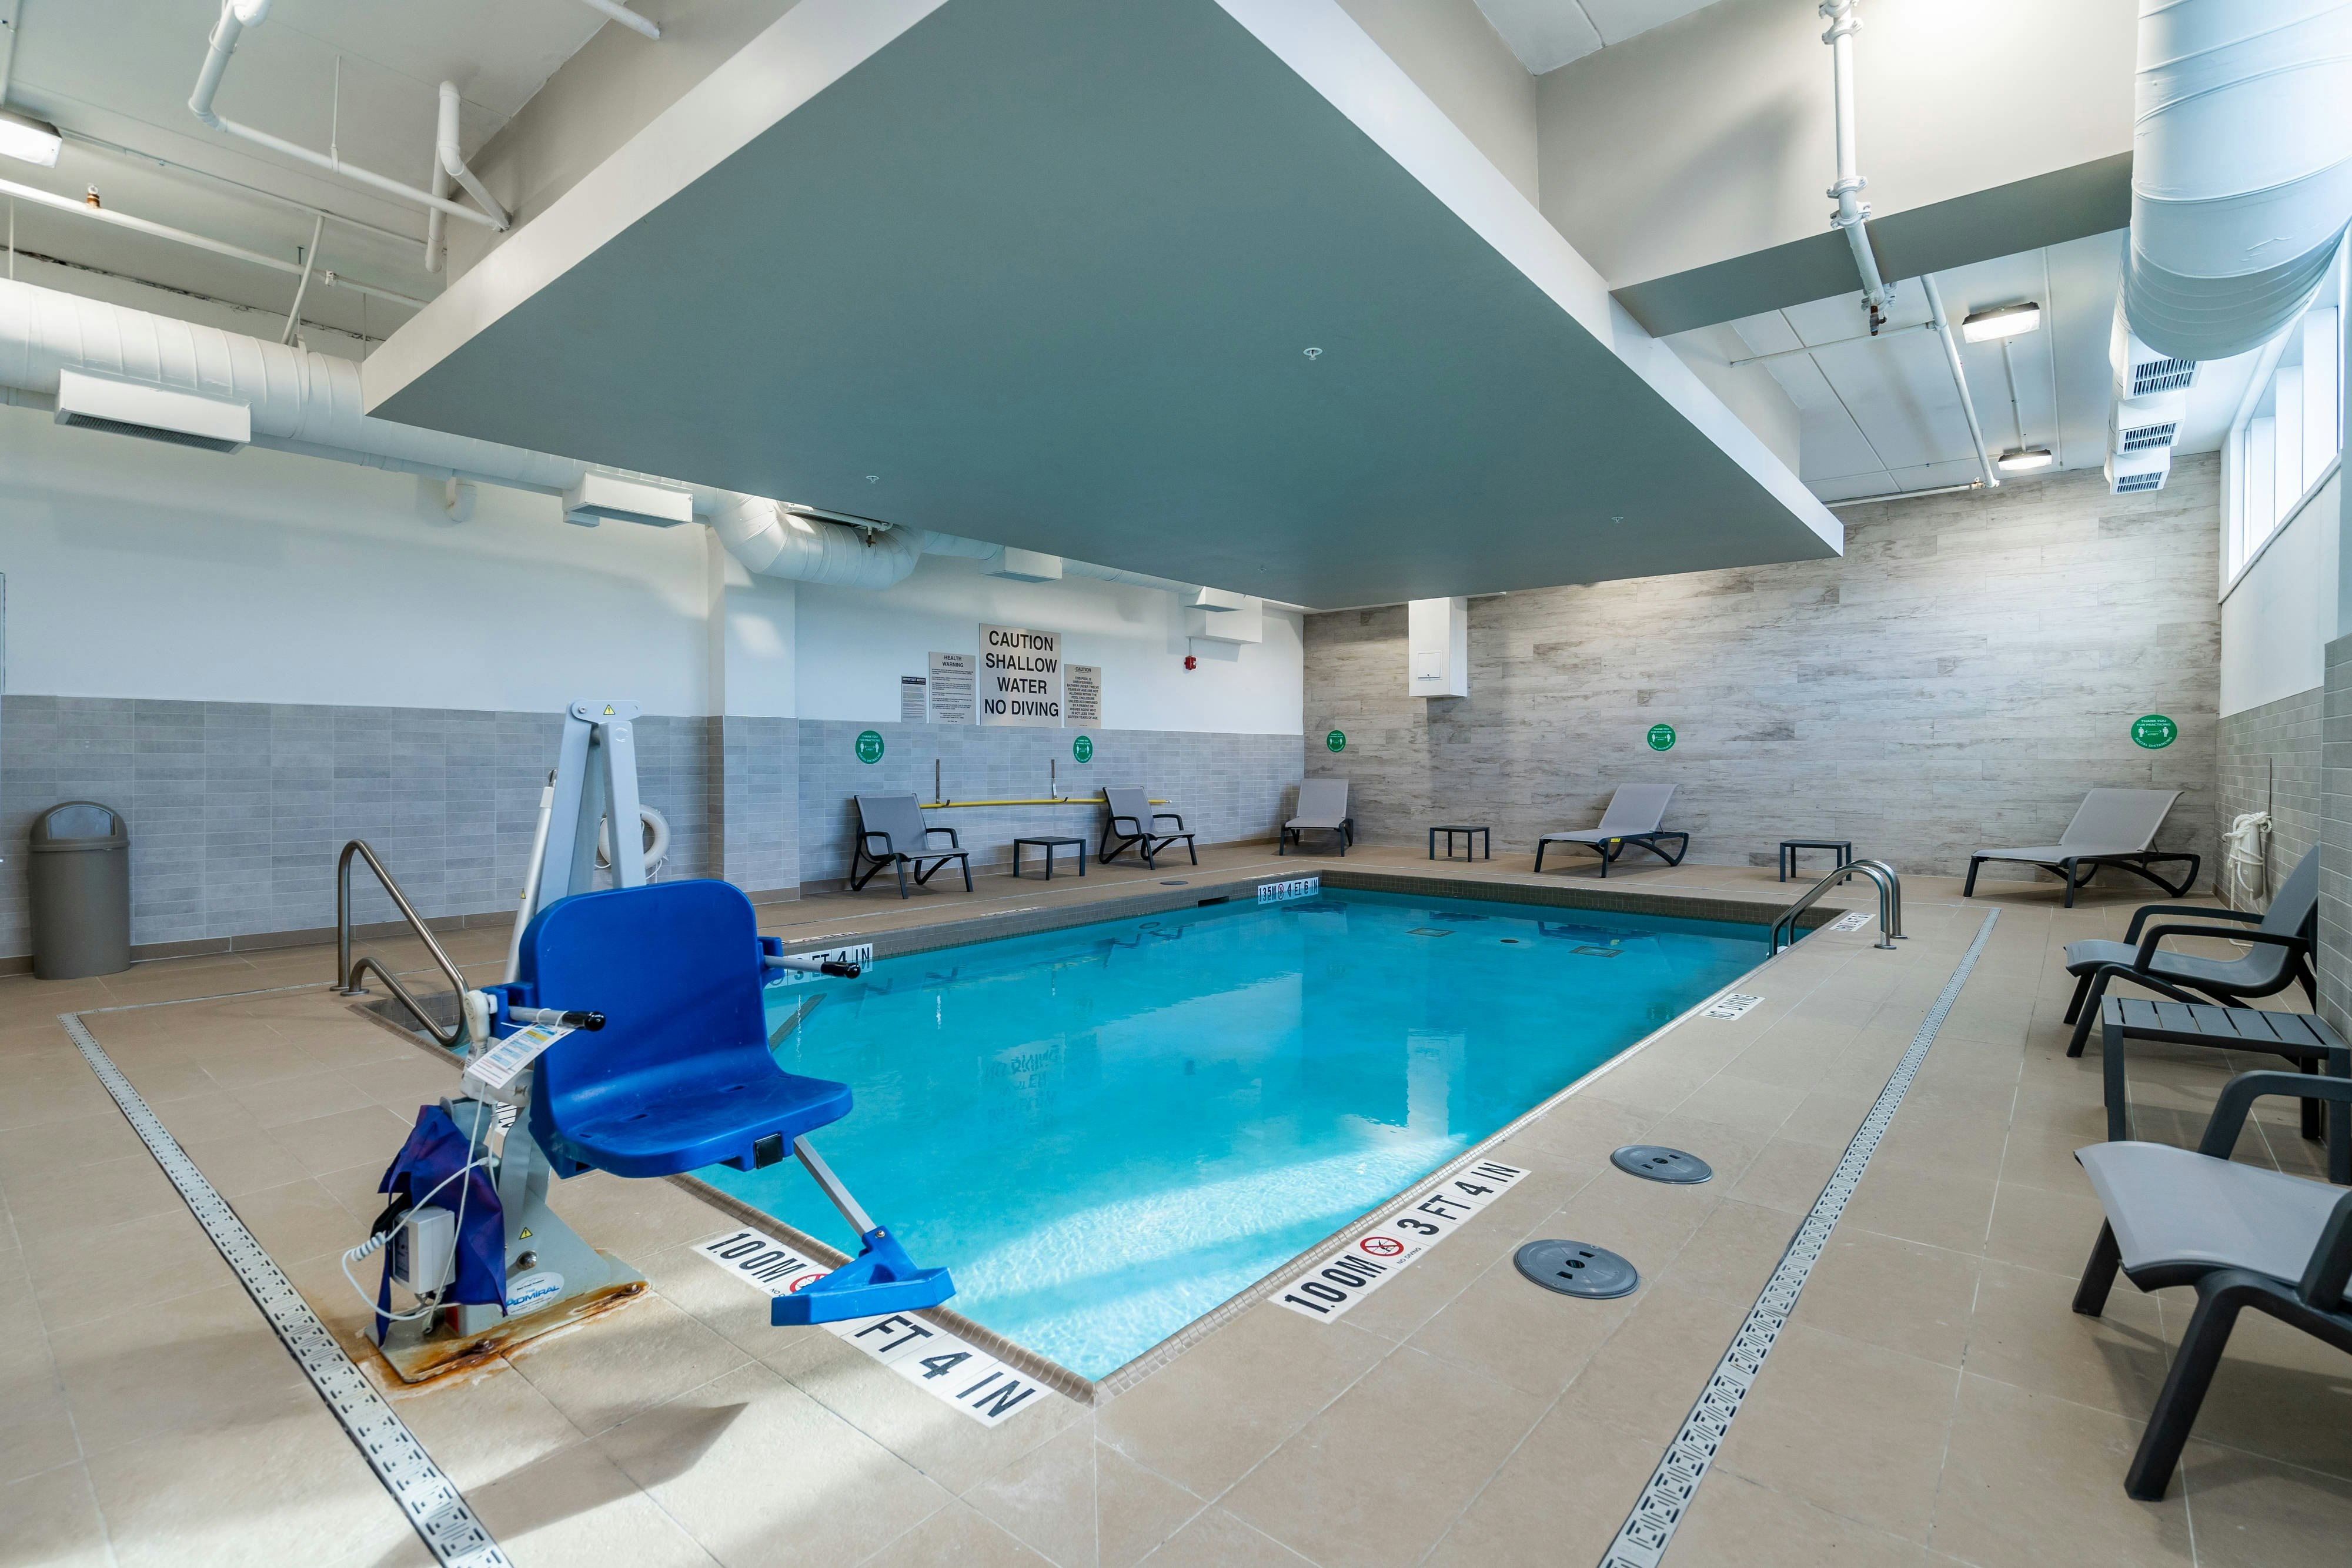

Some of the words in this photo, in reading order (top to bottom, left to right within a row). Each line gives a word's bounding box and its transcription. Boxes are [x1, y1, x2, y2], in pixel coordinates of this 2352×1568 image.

[989, 630, 1053, 651] CAUTION
[985, 653, 1057, 673] SHALLOW
[997, 677, 1047, 694] WATER
[985, 698, 1005, 714] NO
[1011, 701, 1058, 717] DIVING
[2136, 737, 2147, 746] SOCIAL
[2149, 737, 2172, 747] DISTANCING
[837, 951, 847, 962] 4
[856, 947, 869, 961] IN
[1717, 995, 1758, 1010] DIVING
[1705, 1011, 1735, 1019] NO
[1471, 1162, 1521, 1183] IN
[1454, 1181, 1494, 1196] 4
[1417, 1195, 1472, 1221] FT
[1396, 1218, 1439, 1235] 3
[1404, 1248, 1421, 1259] DIVING
[1284, 1255, 1388, 1313] 1.00M
[506, 1286, 560, 1308] ADMIRAL
[706, 1233, 807, 1283] 1.00M
[854, 1315, 934, 1352] FT
[918, 1351, 973, 1379] 4
[956, 1371, 1036, 1418] IN
